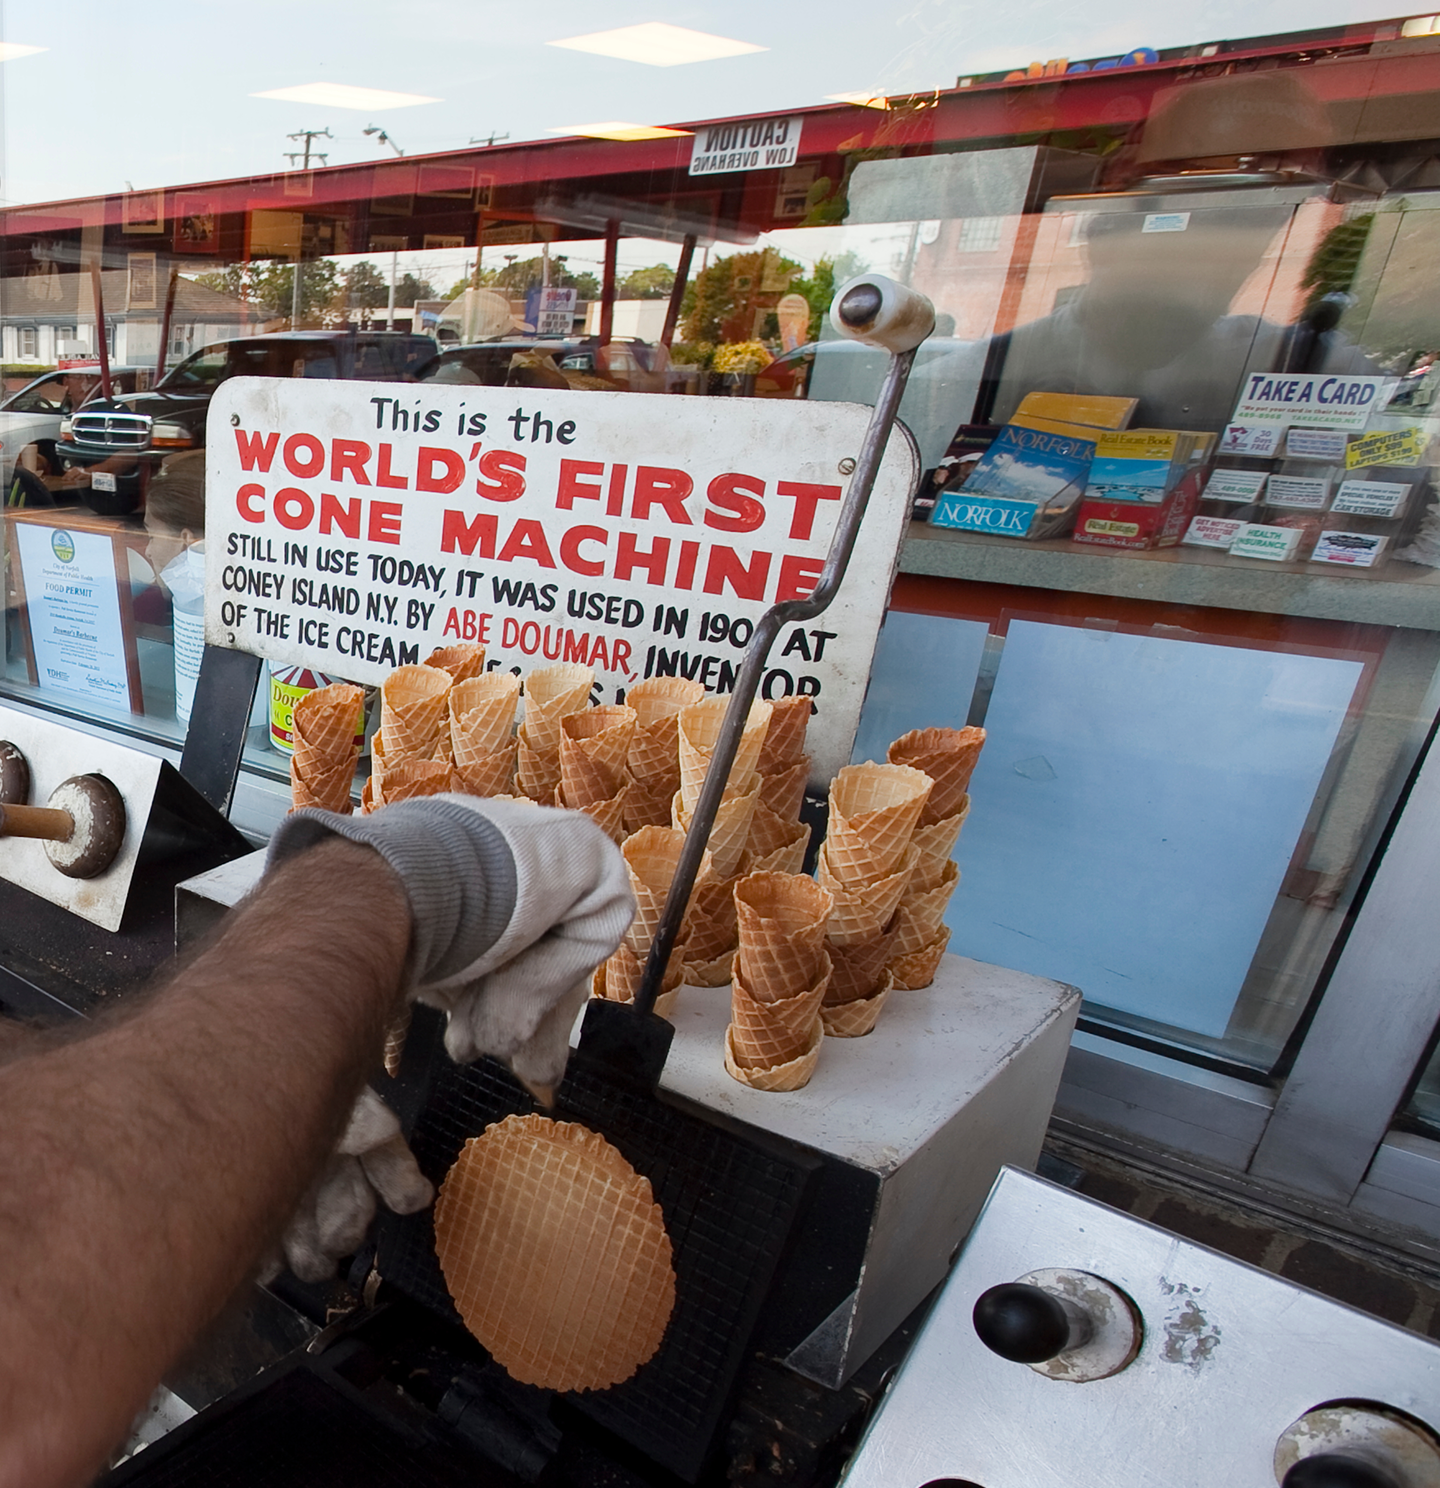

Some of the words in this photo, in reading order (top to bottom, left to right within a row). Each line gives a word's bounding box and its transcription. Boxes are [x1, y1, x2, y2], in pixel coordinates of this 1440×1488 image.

[1247, 376, 1300, 402] TAKE
[1296, 381, 1314, 403] A
[1317, 378, 1376, 405] CARD
[370, 397, 442, 433] This
[458, 402, 487, 436] is
[508, 407, 577, 445] the
[1292, 415, 1363, 424] TAKEACARD.NET
[1002, 427, 1096, 461] NORFOLK
[1147, 436, 1173, 445] Book
[1350, 429, 1412, 452] COMPUTERS
[1359, 445, 1382, 457] ONLY
[234, 429, 527, 503] WORLD'S
[555, 458, 842, 541] FIRST
[938, 502, 1031, 530] NORFOLK
[1334, 503, 1351, 511] CAR
[1352, 505, 1392, 515] STORAGE
[1087, 520, 1108, 530] Real
[1246, 529, 1283, 540] HEALTH
[236, 483, 403, 545] CONE
[441, 508, 826, 604] MACHINE
[1235, 537, 1288, 550] INSURANCE
[45, 582, 65, 593] FOOD
[65, 586, 93, 598] PERMIT
[226, 532, 277, 563] STILL
[283, 541, 308, 568] IN
[316, 546, 359, 576] USE
[367, 553, 447, 599] TODAY,
[455, 569, 485, 598] IT
[492, 576, 558, 612] WAS
[567, 589, 644, 628] USED
[652, 604, 689, 639] IN
[699, 612, 755, 648] 190
[781, 628, 838, 663] AT
[221, 601, 248, 627] OF
[253, 607, 290, 639] THE
[298, 618, 329, 649] ICE
[336, 626, 420, 668] CREAM
[222, 565, 285, 600] CONEY
[291, 578, 360, 615] ISLAND
[366, 592, 399, 626] N.Y.
[406, 598, 435, 631] BY
[442, 607, 493, 644] ABE
[501, 617, 638, 683] DOUMAR,
[644, 645, 821, 715] INVENOR
